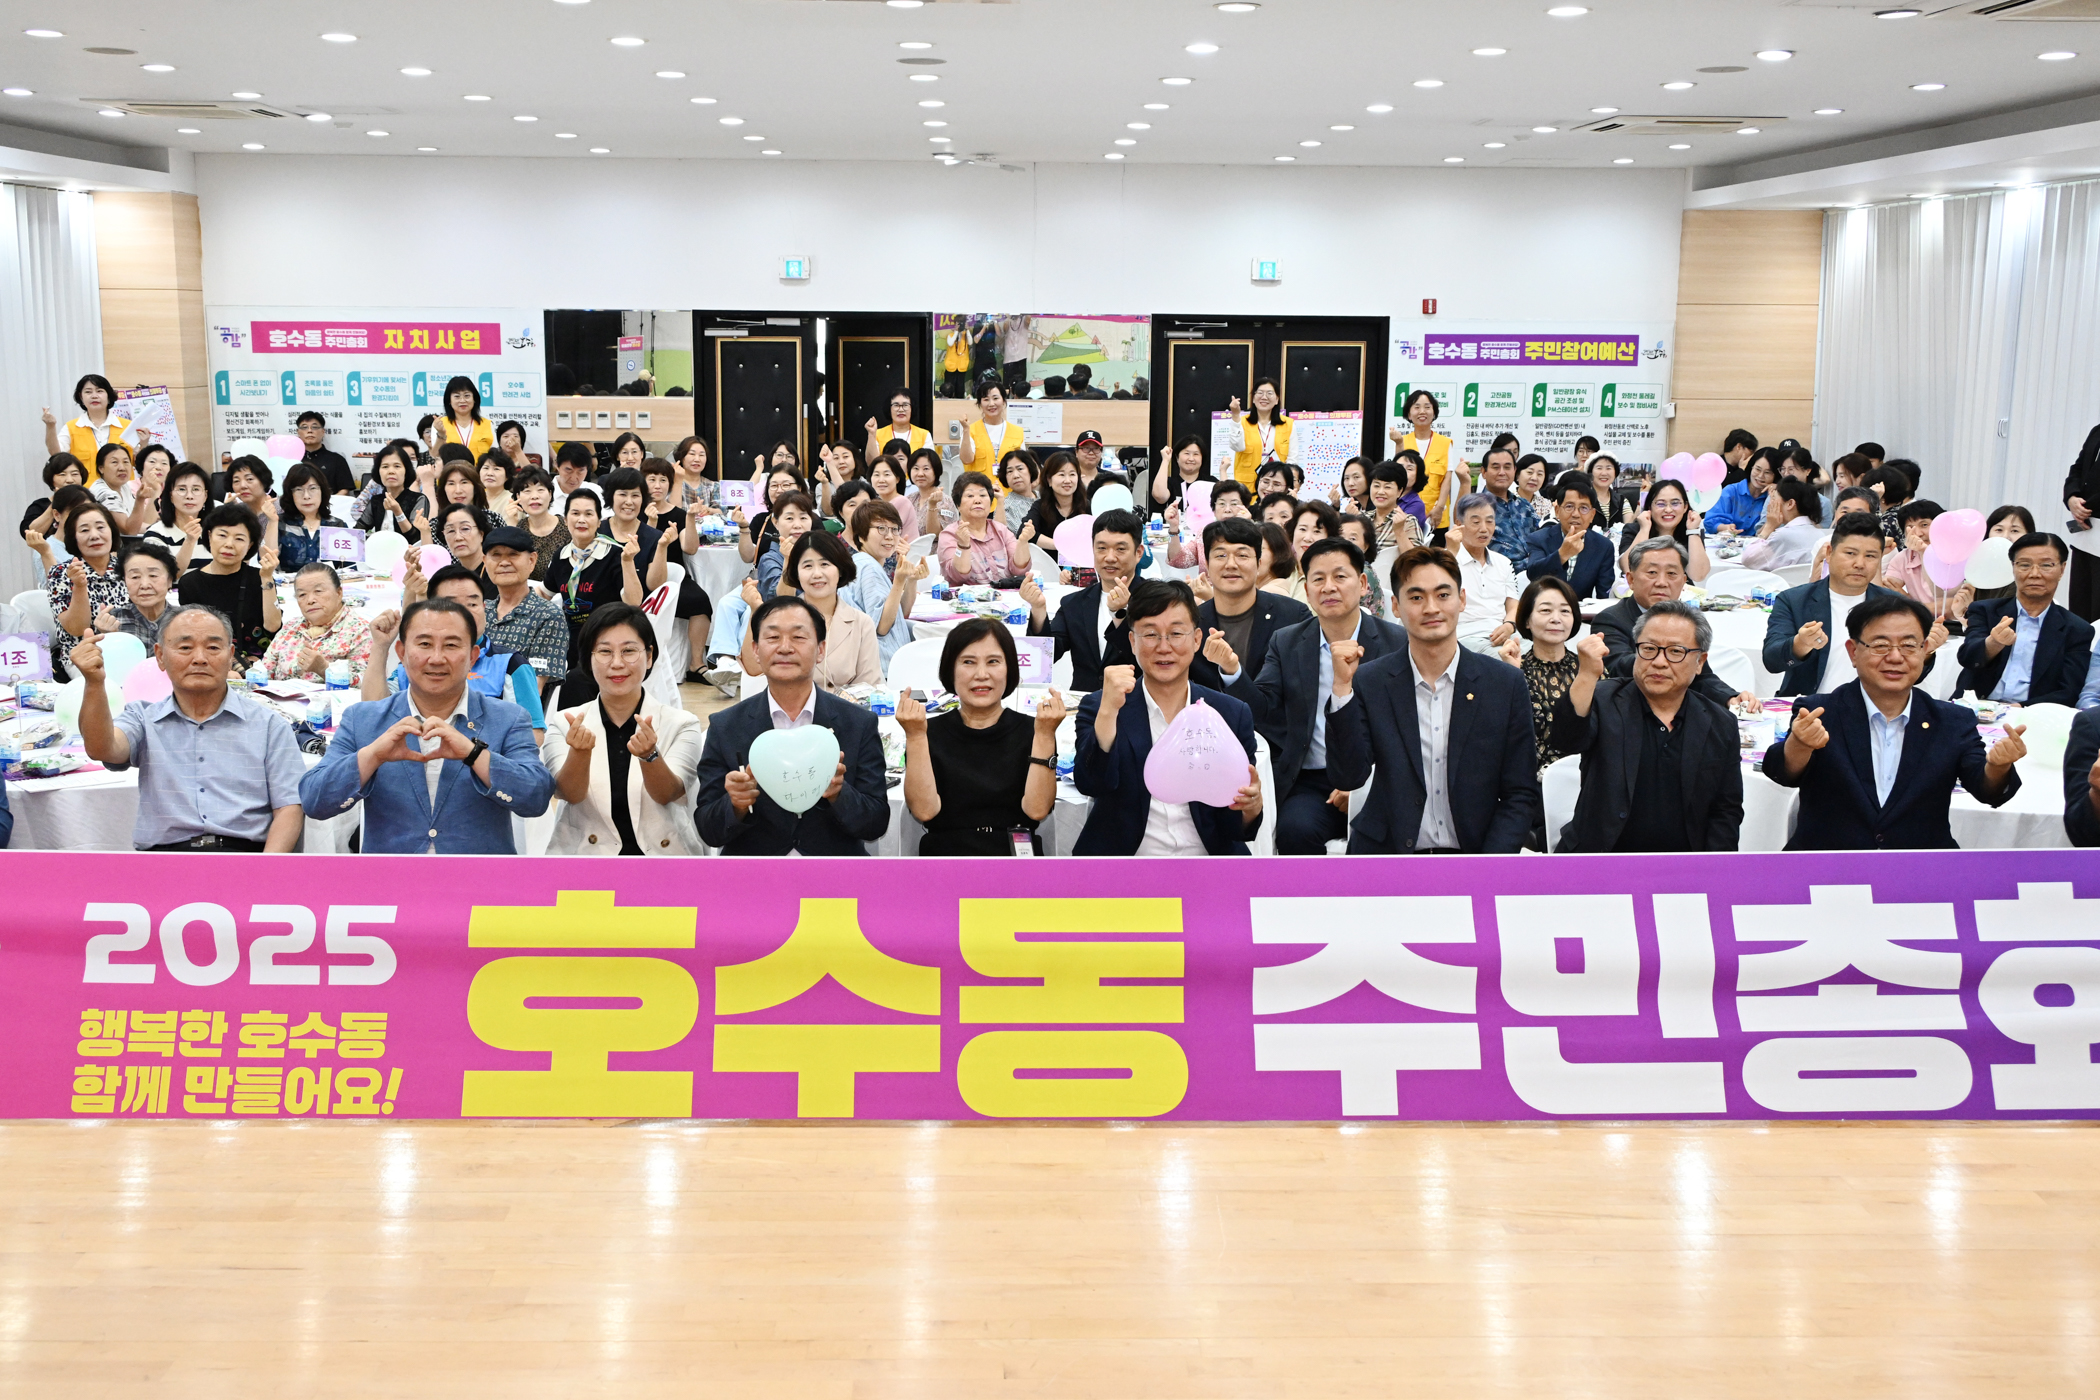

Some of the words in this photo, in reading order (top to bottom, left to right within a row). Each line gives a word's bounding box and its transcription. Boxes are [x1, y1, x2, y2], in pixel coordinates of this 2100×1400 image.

[268, 329, 322, 348] 호수동
[325, 336, 368, 348] 주민총회
[1428, 342, 1478, 359] 호수동
[1480, 349, 1520, 360] 주민총회
[1525, 341, 1636, 361] 주민참여예산
[219, 380, 226, 396] 1
[285, 380, 294, 396] 2
[350, 381, 359, 397] 3
[416, 381, 425, 397] 4
[481, 382, 490, 398] 5
[1400, 392, 1406, 408] 1
[1467, 392, 1476, 408] 2
[1535, 392, 1544, 408] 3
[1604, 392, 1613, 408] 4
[730, 489, 744, 497] 8조
[334, 539, 352, 550] 6조
[0, 650, 28, 666] 1조
[1017, 654, 1031, 667] 조
[82, 901, 398, 987] 2025
[461, 889, 1189, 1118] 호수동
[76, 1008, 229, 1058] 행복한
[236, 1010, 389, 1060] 호수동
[71, 1064, 170, 1114] 함께
[182, 1066, 404, 1116] 만들어요!
